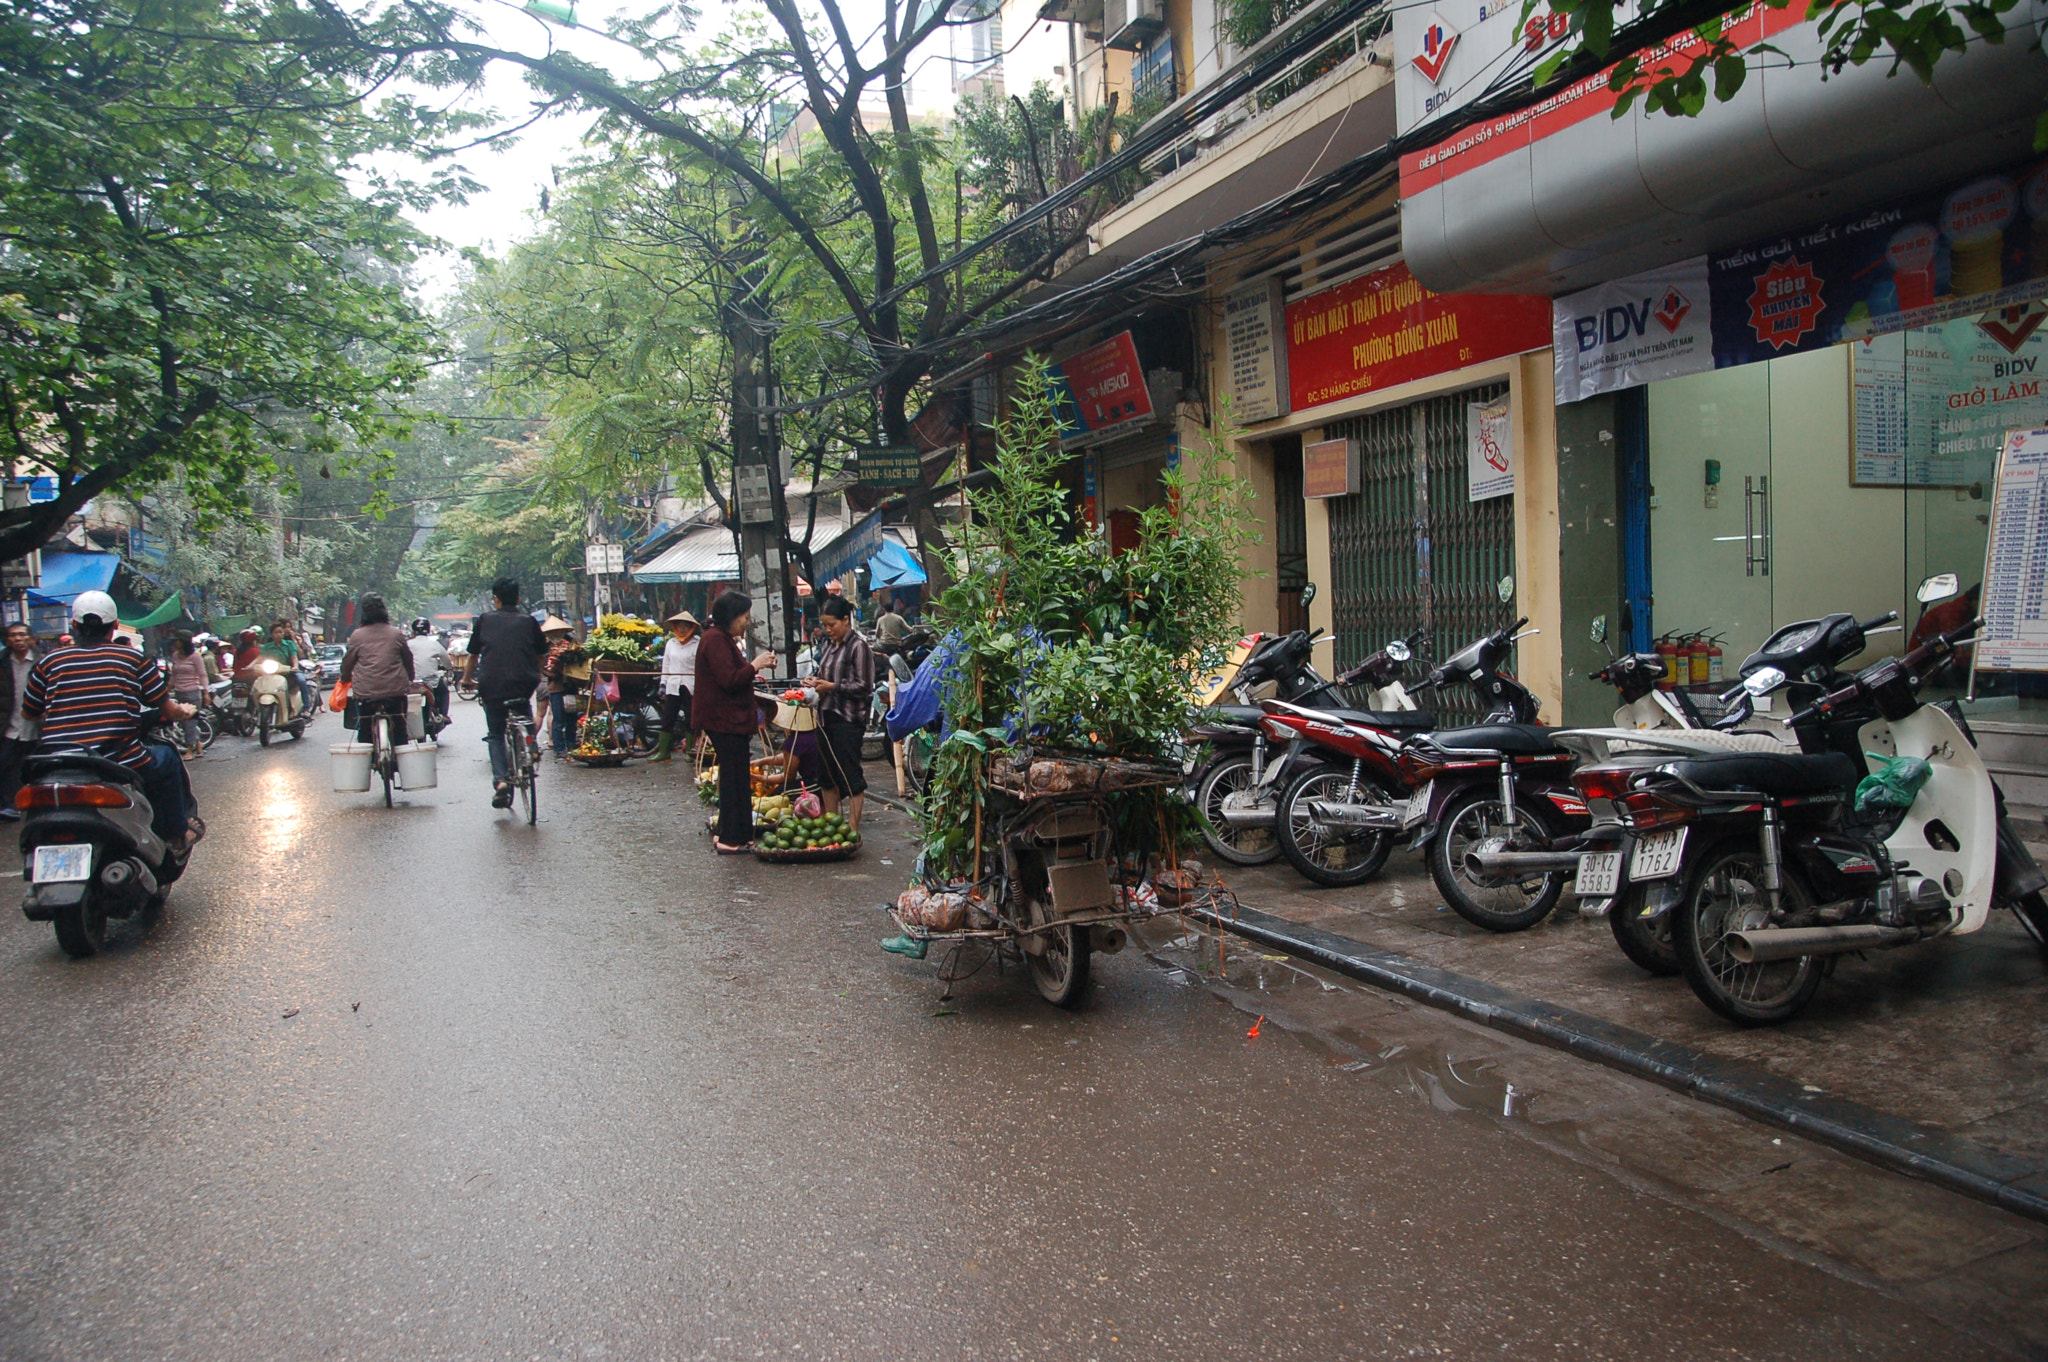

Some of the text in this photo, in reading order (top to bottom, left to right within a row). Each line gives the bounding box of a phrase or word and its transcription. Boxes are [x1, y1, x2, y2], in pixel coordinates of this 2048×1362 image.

[1425, 87, 1452, 113] BIDV
[1438, 145, 1456, 162] GIAO
[1457, 137, 1474, 155] DỊCH
[1495, 121, 1505, 136] 50
[1766, 276, 1806, 298] Siêu
[1293, 314, 1305, 345] ỦY
[1308, 312, 1326, 341] BAN
[1328, 301, 1349, 335] MẶT
[1352, 292, 1378, 326] TRẬN
[1574, 297, 1652, 353] BIDV
[1353, 310, 1459, 370] PHƯỜNG ĐỒNG XUÂN
[1680, 336, 1694, 346] NAM
[1459, 348, 1473, 361] ĐT:
[1994, 356, 2038, 378] BIDV
[1307, 372, 1372, 403] ĐC: 52 HÀNG CHIẾU
[1948, 380, 2040, 409] GIỜ LÀM
[1809, 794, 1838, 803] HONDA
[1583, 854, 1615, 873] 30-K2
[1638, 852, 1672, 875] 1762
[1580, 874, 1612, 892] 5583
